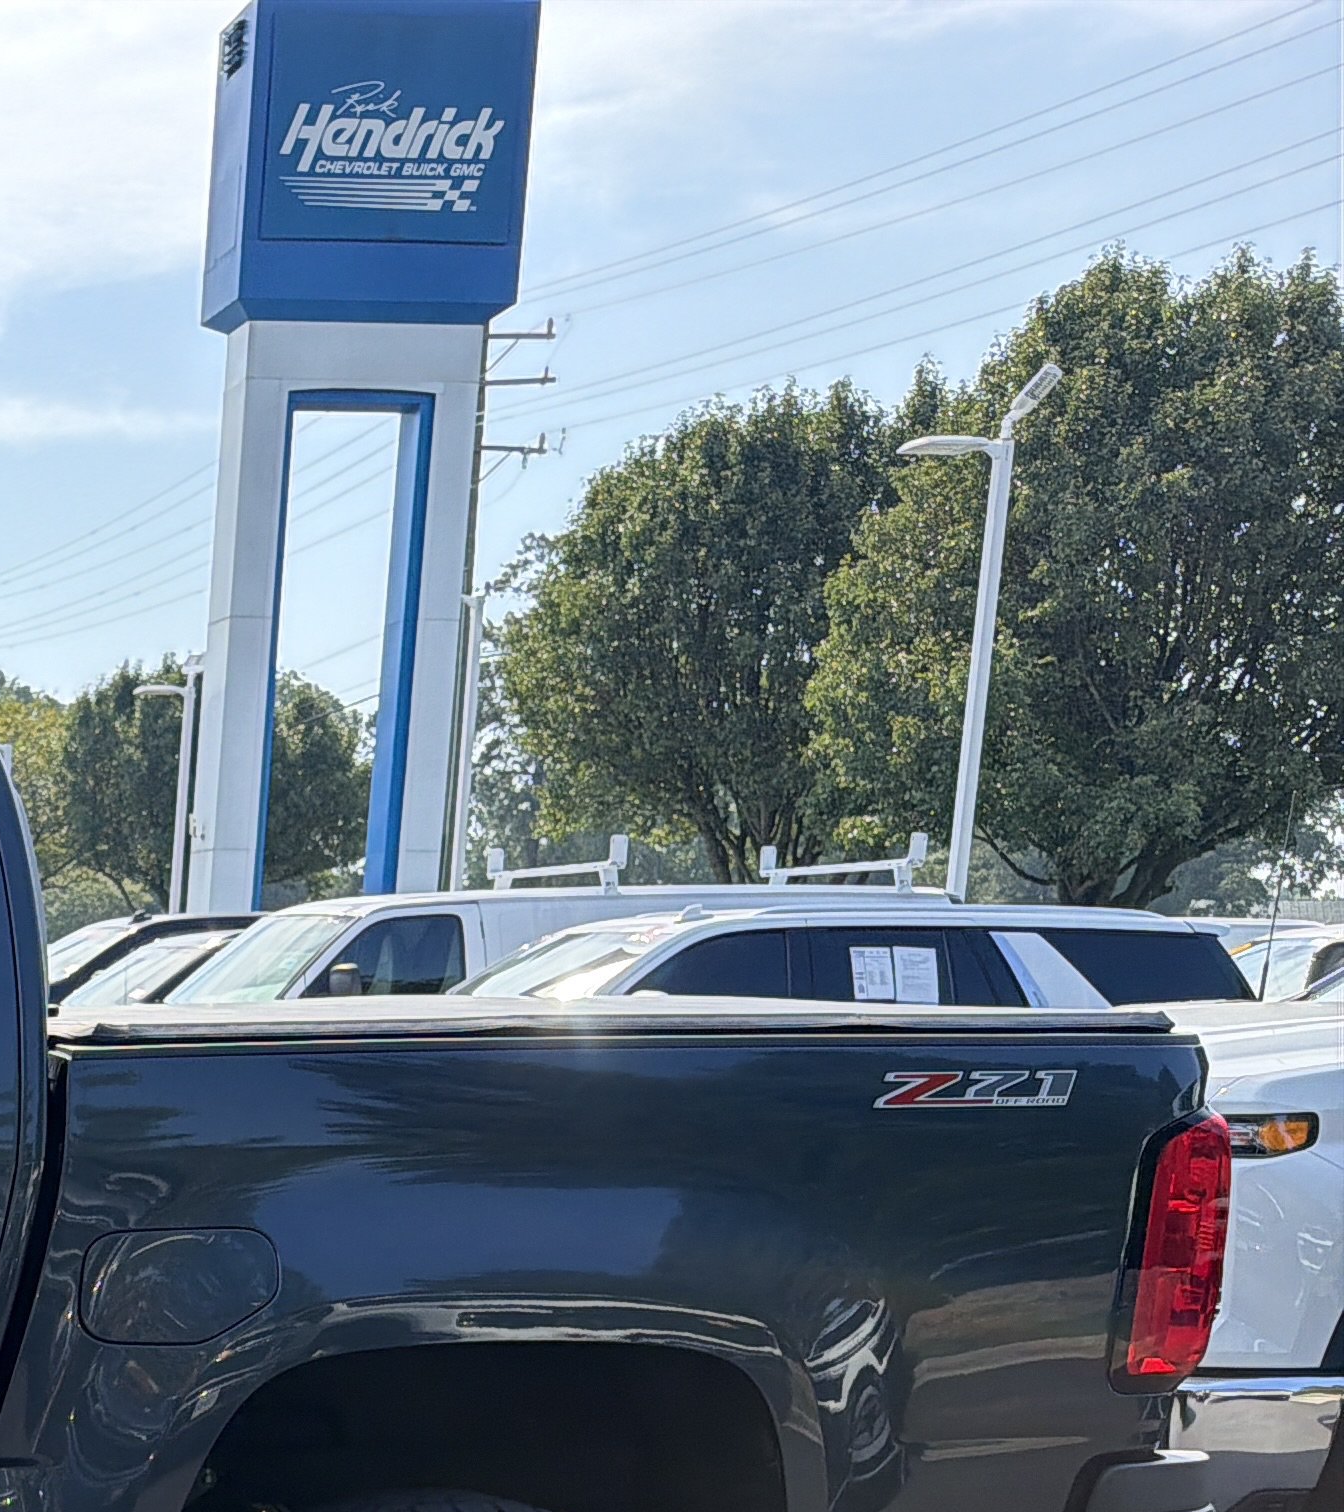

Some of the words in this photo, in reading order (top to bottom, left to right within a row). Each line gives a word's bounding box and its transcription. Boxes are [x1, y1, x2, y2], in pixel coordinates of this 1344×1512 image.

[279, 103, 505, 173] Hendrick
[315, 160, 401, 175] CHEVROLET
[402, 162, 448, 176] BUICK
[450, 163, 486, 177] GMC
[872, 1069, 1078, 1109] Z71
